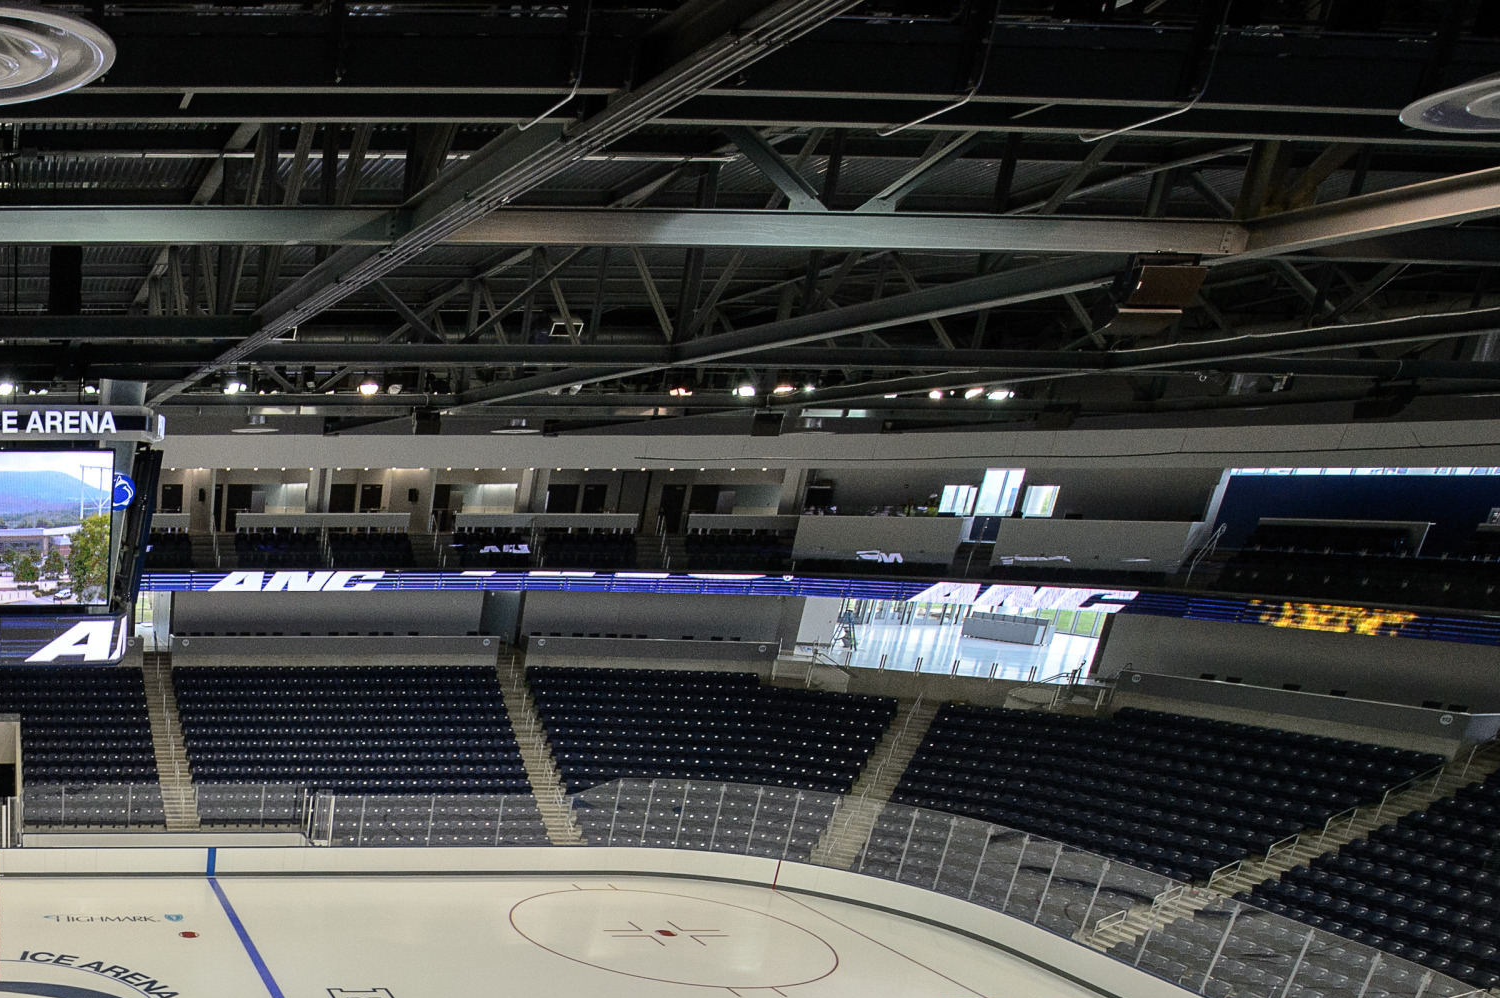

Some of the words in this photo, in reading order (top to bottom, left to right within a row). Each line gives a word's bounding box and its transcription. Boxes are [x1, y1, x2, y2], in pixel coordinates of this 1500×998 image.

[25, 411, 117, 434] ARENA
[207, 571, 386, 591] ANC
[906, 581, 1140, 613] ANC
[44, 914, 156, 922] HIGHMARK
[19, 950, 79, 966] ICE
